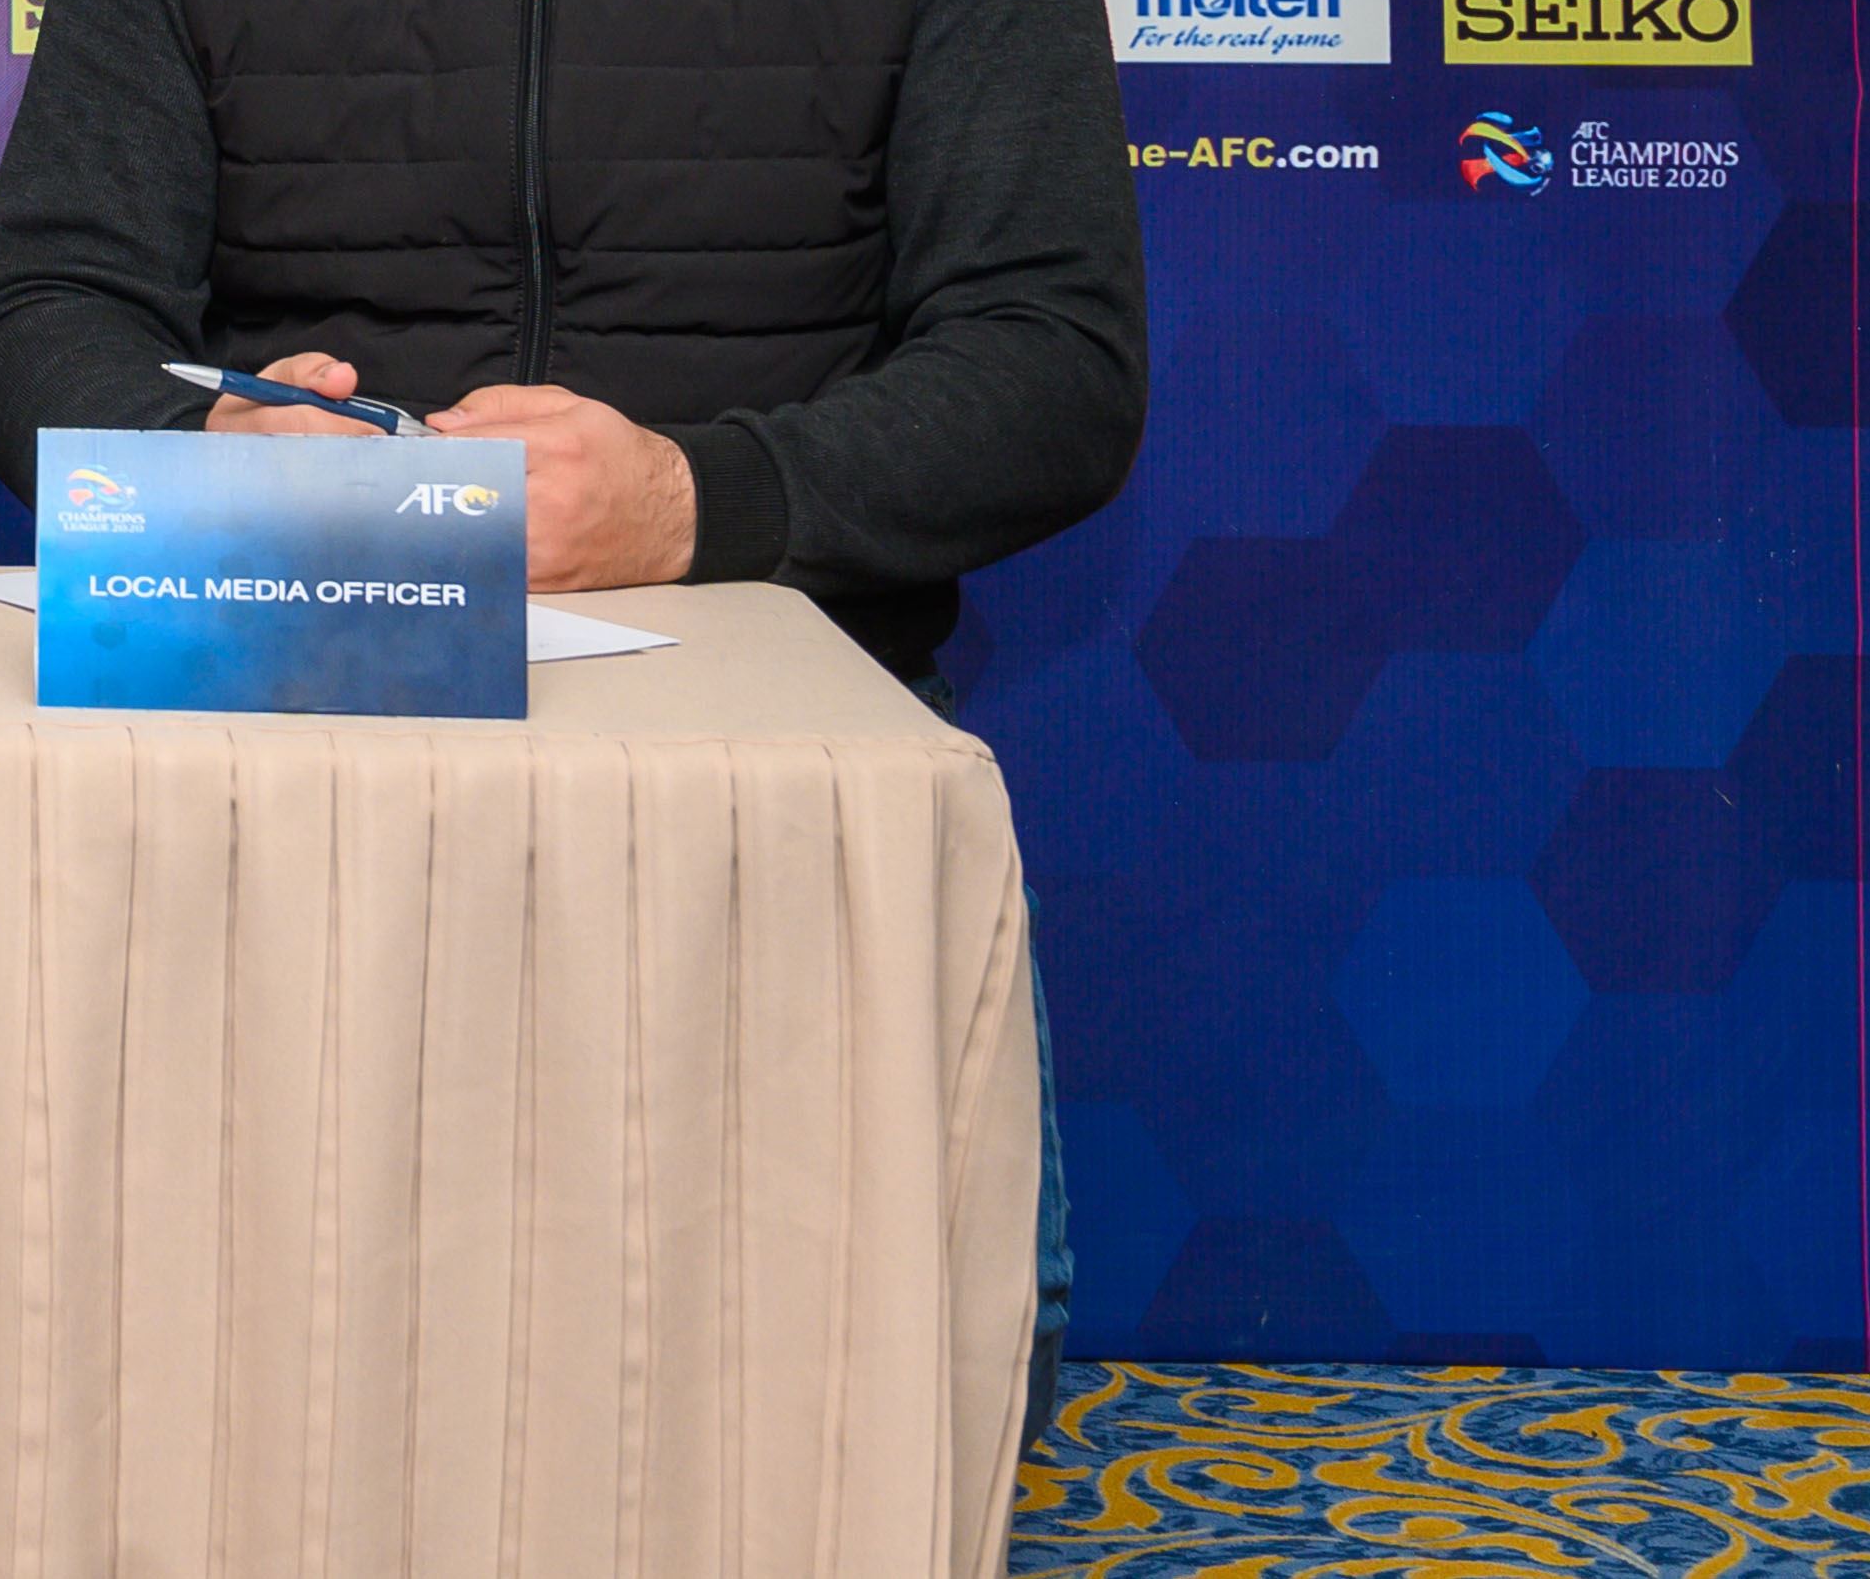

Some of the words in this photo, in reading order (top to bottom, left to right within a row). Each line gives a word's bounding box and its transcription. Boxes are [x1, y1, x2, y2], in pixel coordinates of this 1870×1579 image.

[1129, 24, 1169, 50] For
[1173, 24, 1216, 48] the
[1221, 26, 1269, 48] real
[1272, 31, 1341, 56] game
[1573, 122, 1609, 140] AFC
[1571, 141, 1738, 165] CHAMPIONS
[1572, 168, 1659, 187] LEAGUE
[1666, 169, 1726, 187] 2020
[395, 484, 481, 516] AFC
[90, 576, 197, 598] LOCAL
[205, 578, 309, 601] MEDIA
[316, 581, 465, 606] OFFICER
